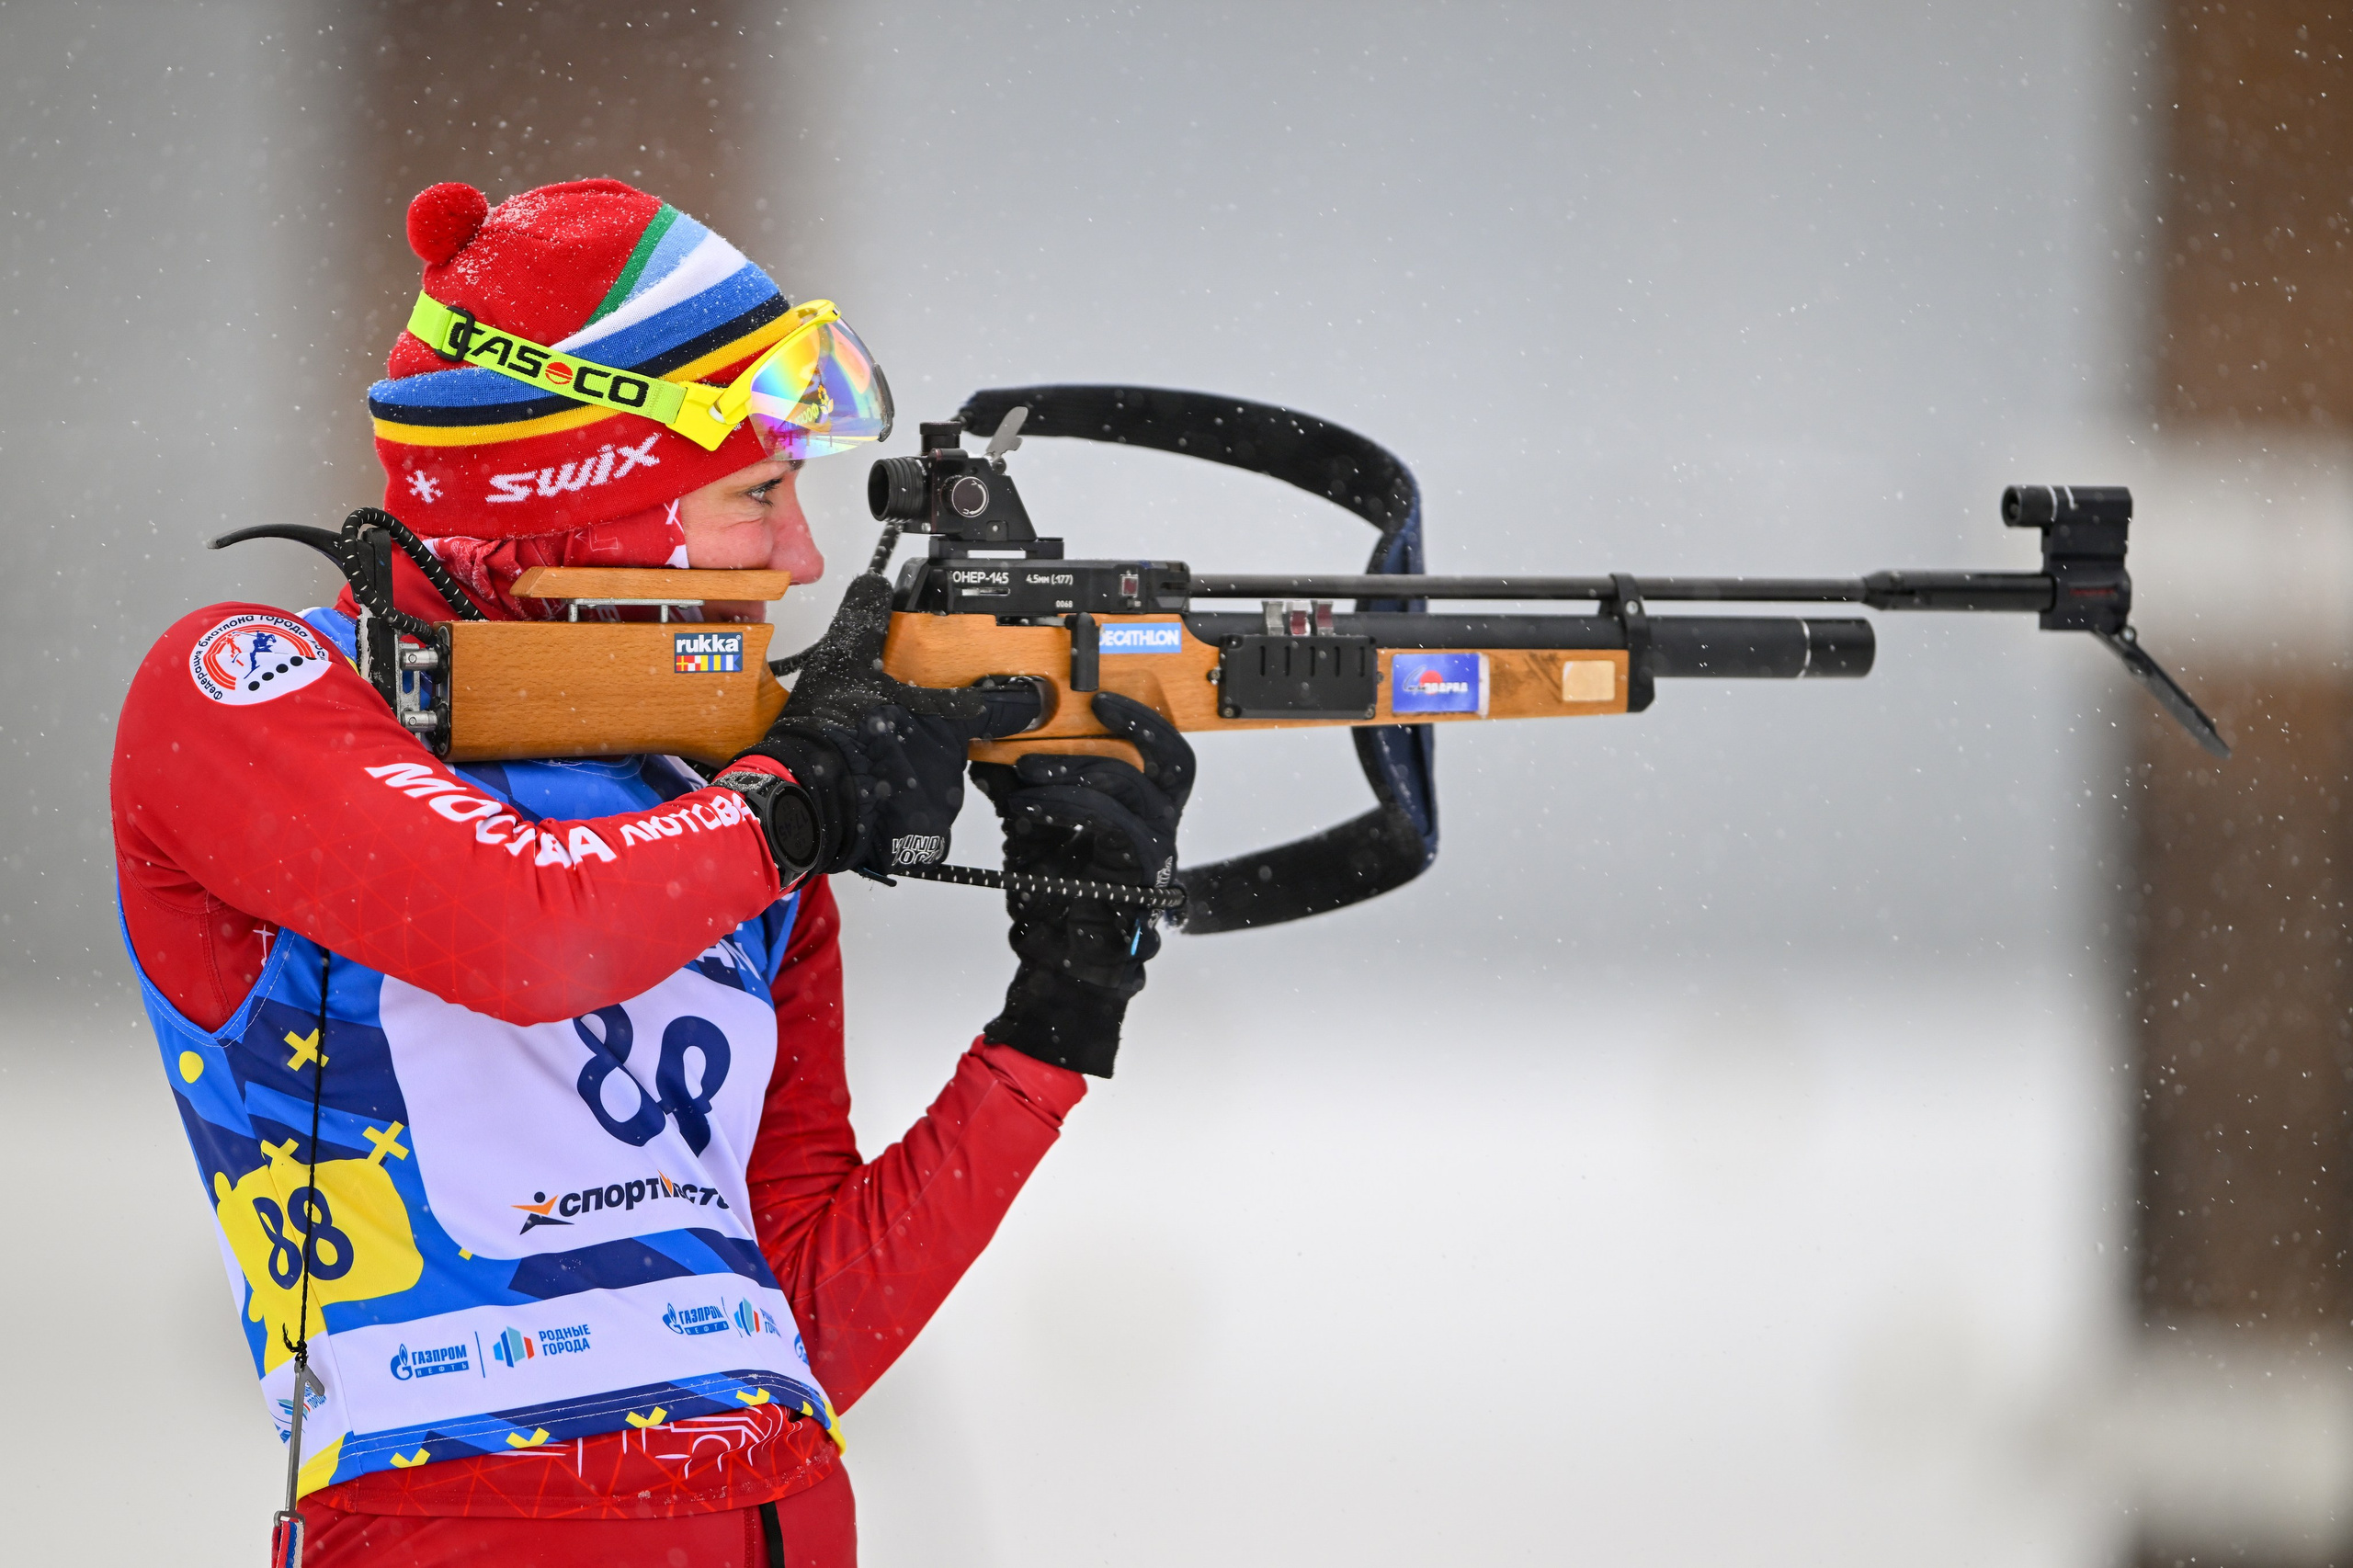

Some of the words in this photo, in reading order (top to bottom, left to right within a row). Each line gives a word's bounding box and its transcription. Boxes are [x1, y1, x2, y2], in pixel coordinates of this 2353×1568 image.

[952, 570, 1009, 585] ОНЕР-145
[1055, 599, 1074, 608] 0068
[676, 634, 739, 653] rukka
[253, 1187, 354, 1290] 88
[539, 1324, 591, 1343] РОДНЫЕ
[412, 1345, 467, 1366] ГАЗПРОМ
[542, 1337, 591, 1356] ГОРОДА
[416, 1362, 467, 1377] НЕФТЬ
